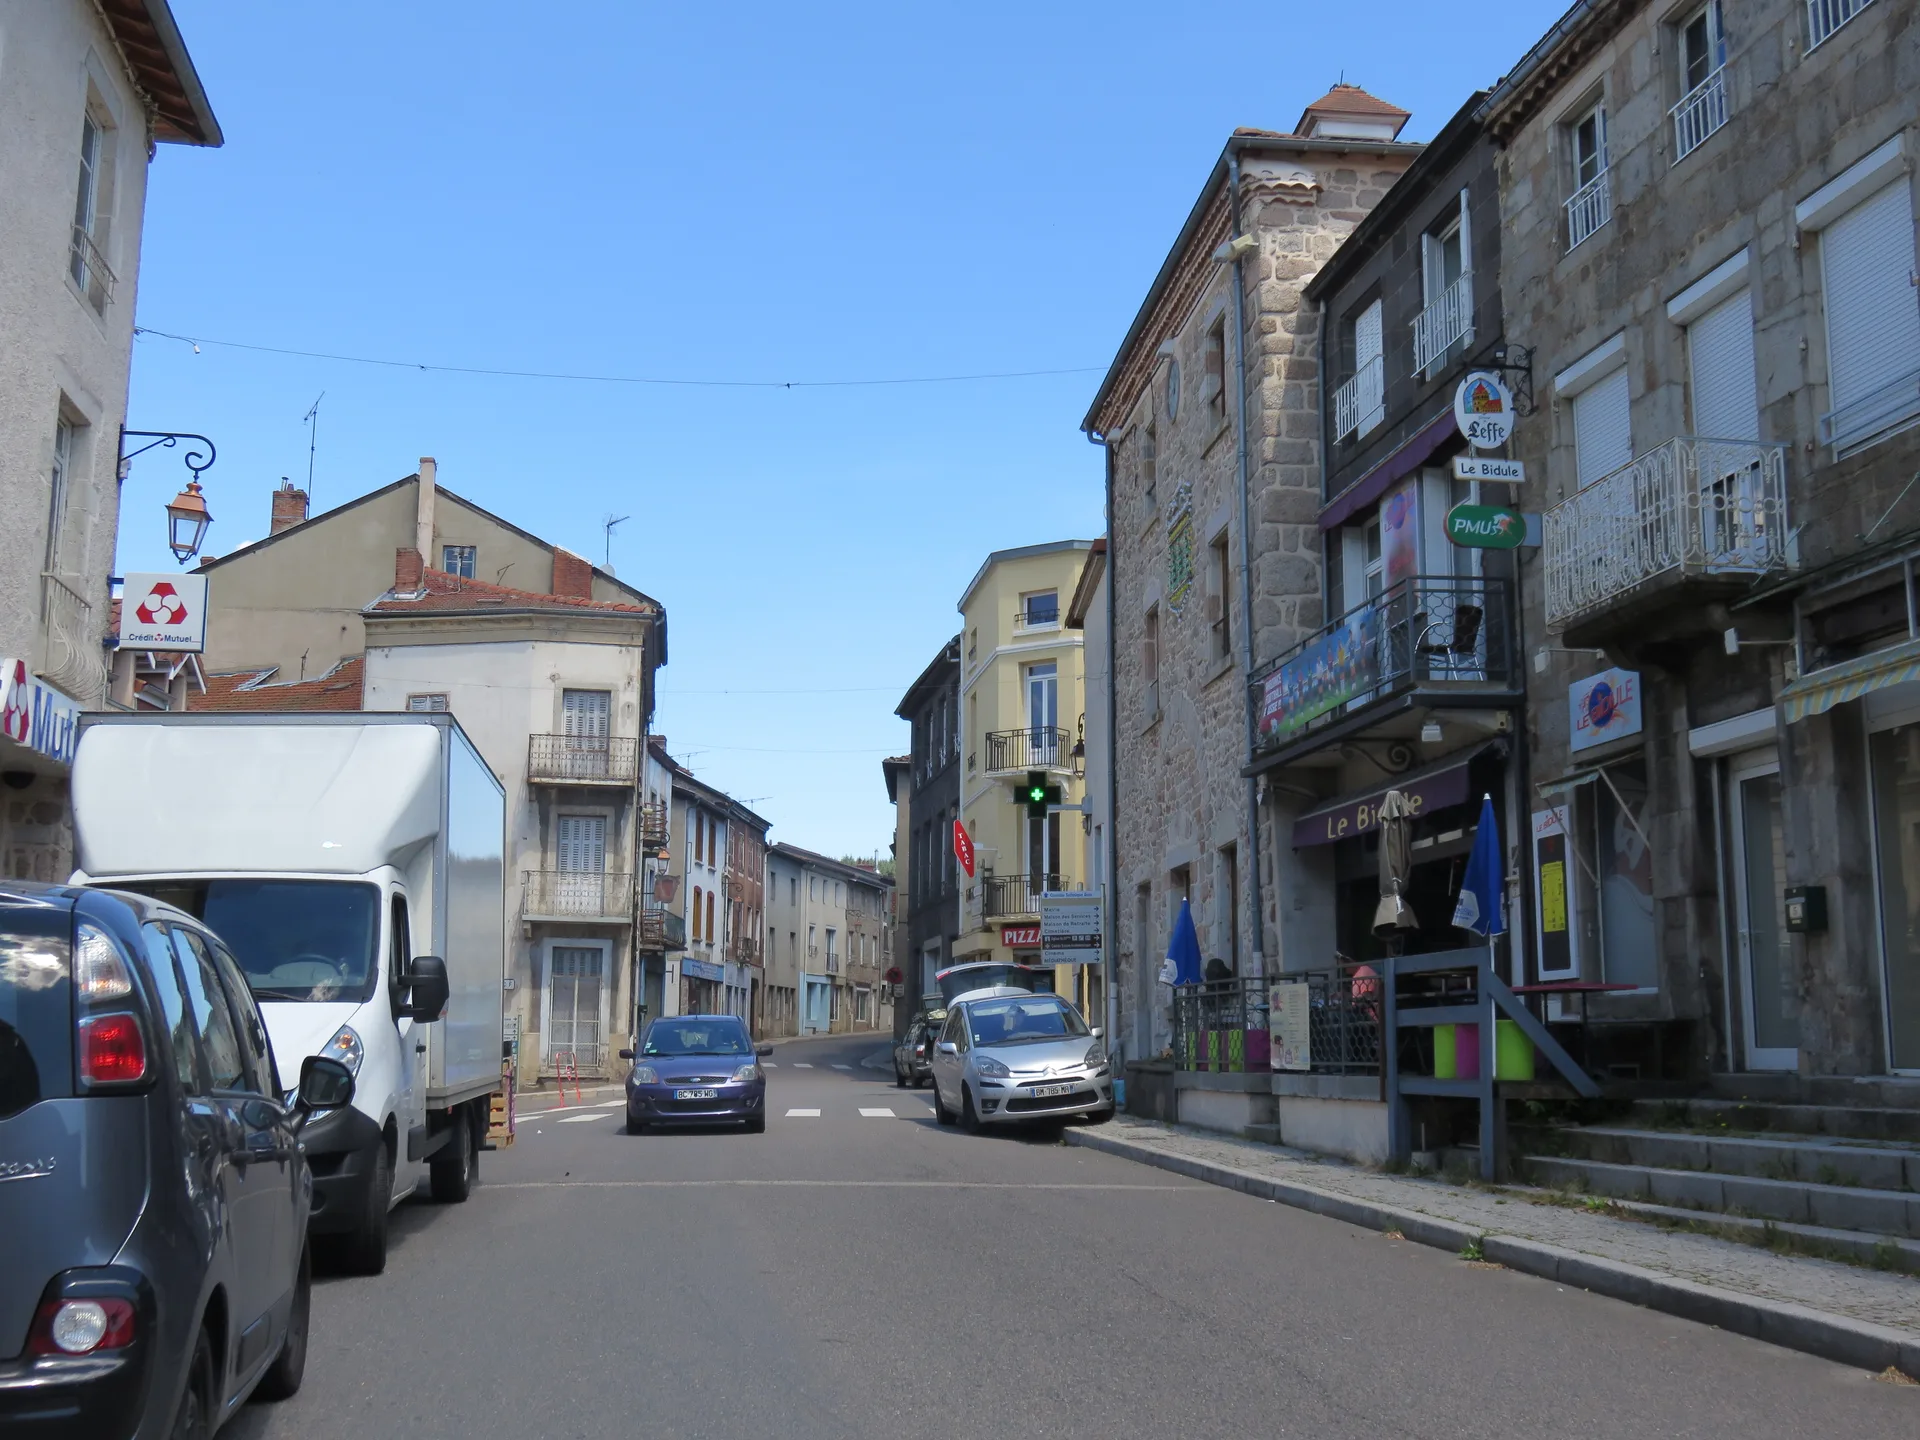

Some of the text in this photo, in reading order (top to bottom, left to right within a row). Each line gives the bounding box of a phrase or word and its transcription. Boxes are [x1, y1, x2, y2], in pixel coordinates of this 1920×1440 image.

[1467, 420, 1505, 442] Leffe
[1461, 462, 1519, 477] Le Bidule
[1454, 518, 1492, 535] PMU
[129, 633, 192, 643] Crédit Mutuel
[1328, 817, 1348, 839] Le
[958, 832, 971, 865] TABAC
